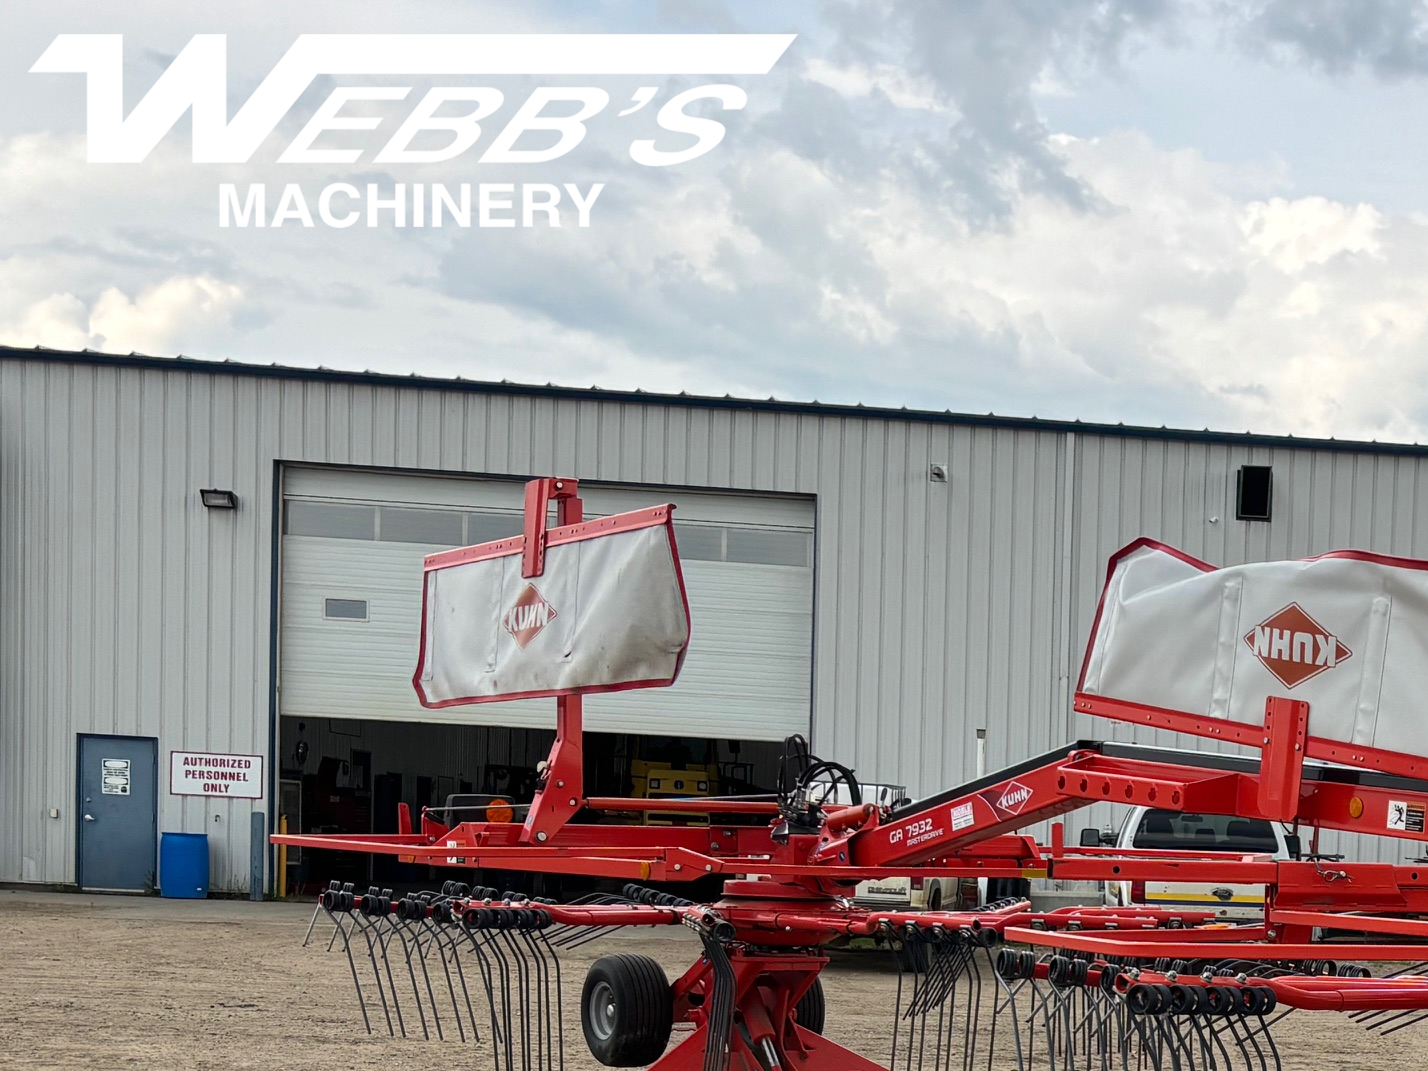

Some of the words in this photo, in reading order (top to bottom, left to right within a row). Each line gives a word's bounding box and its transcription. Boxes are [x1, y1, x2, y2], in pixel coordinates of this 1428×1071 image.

[507, 602, 549, 632] KUHN
[1253, 624, 1338, 668] KUHN
[183, 756, 251, 769] AUTHORIZED
[184, 769, 249, 782] PERSONNEL
[203, 782, 230, 794] ONLY
[1001, 788, 1029, 809] KUHN
[889, 828, 904, 844] GA
[905, 817, 933, 838] 7932
[906, 827, 945, 847] MASTERDRIVE
